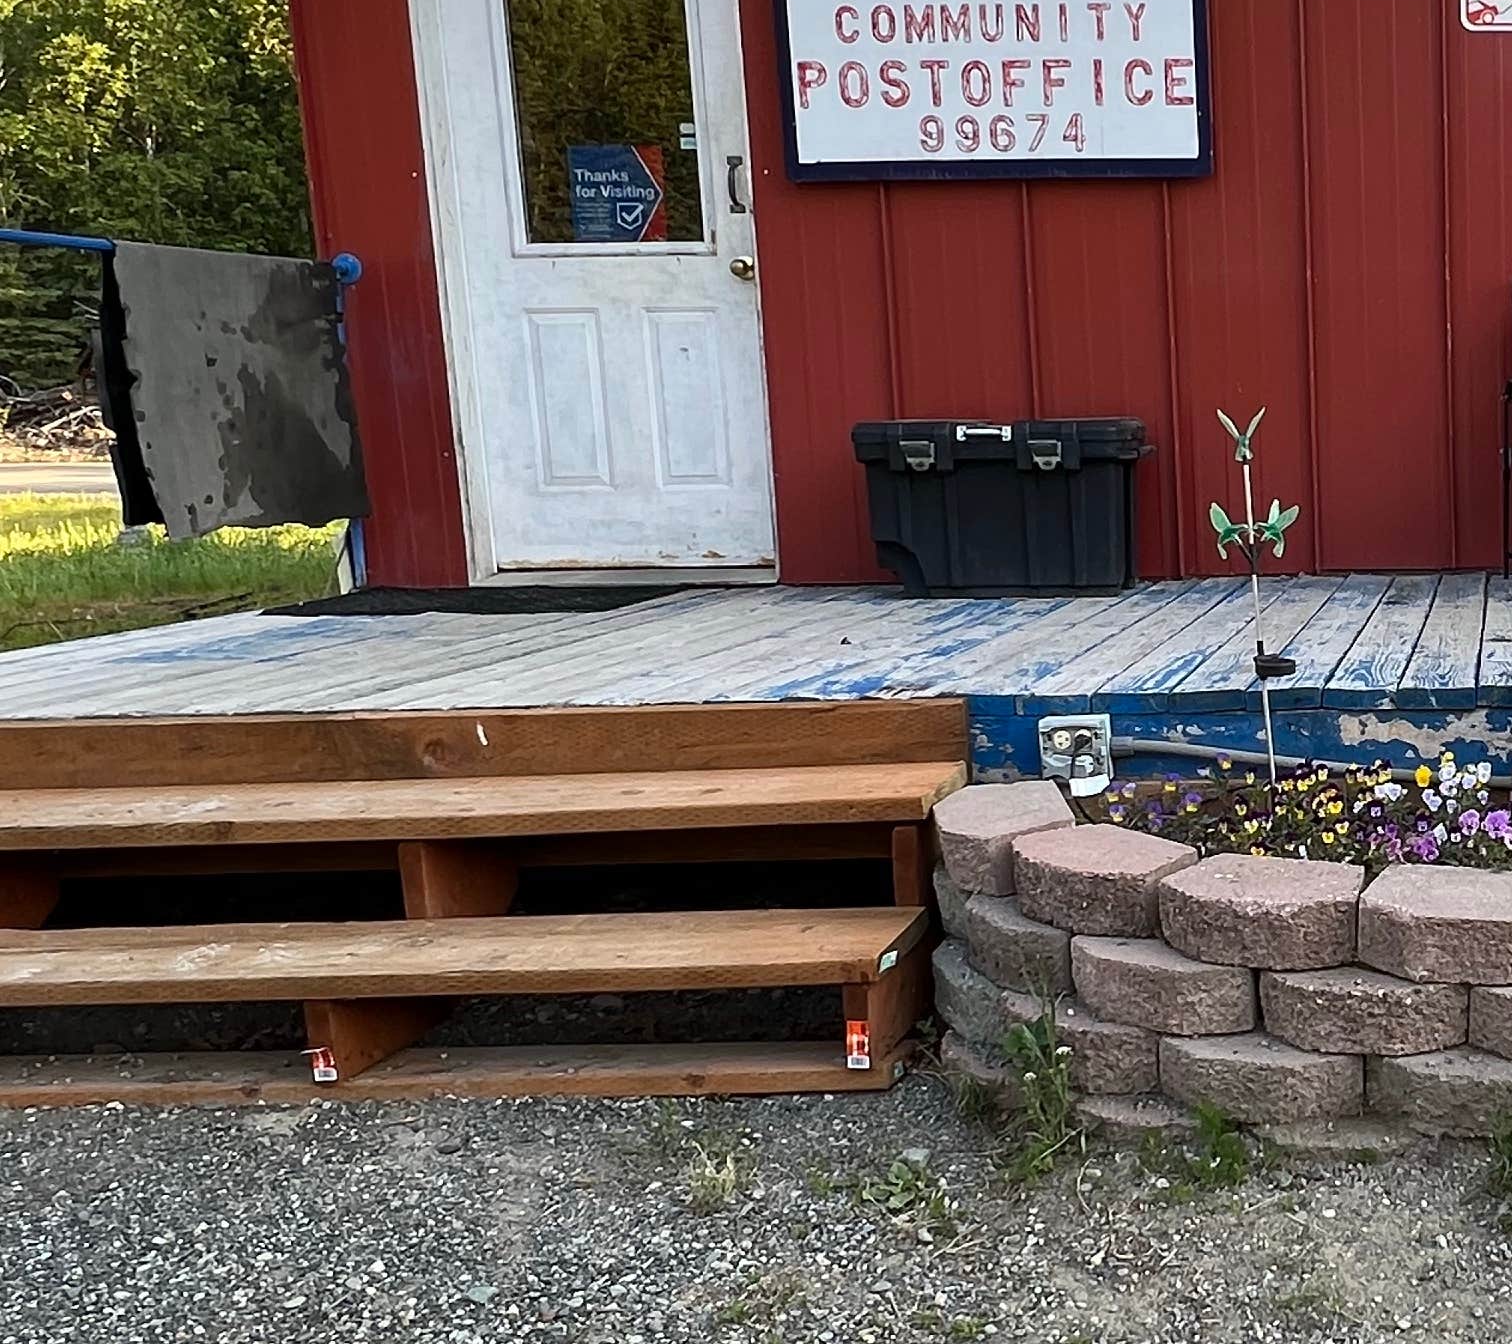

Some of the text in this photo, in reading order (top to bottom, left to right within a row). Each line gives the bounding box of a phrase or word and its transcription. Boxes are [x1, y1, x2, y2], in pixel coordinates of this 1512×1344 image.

[834, 2, 1147, 44] COMMUNITY
[918, 112, 1087, 153] 99674
[573, 168, 629, 182] Thanks
[575, 184, 655, 201] for Visiting
